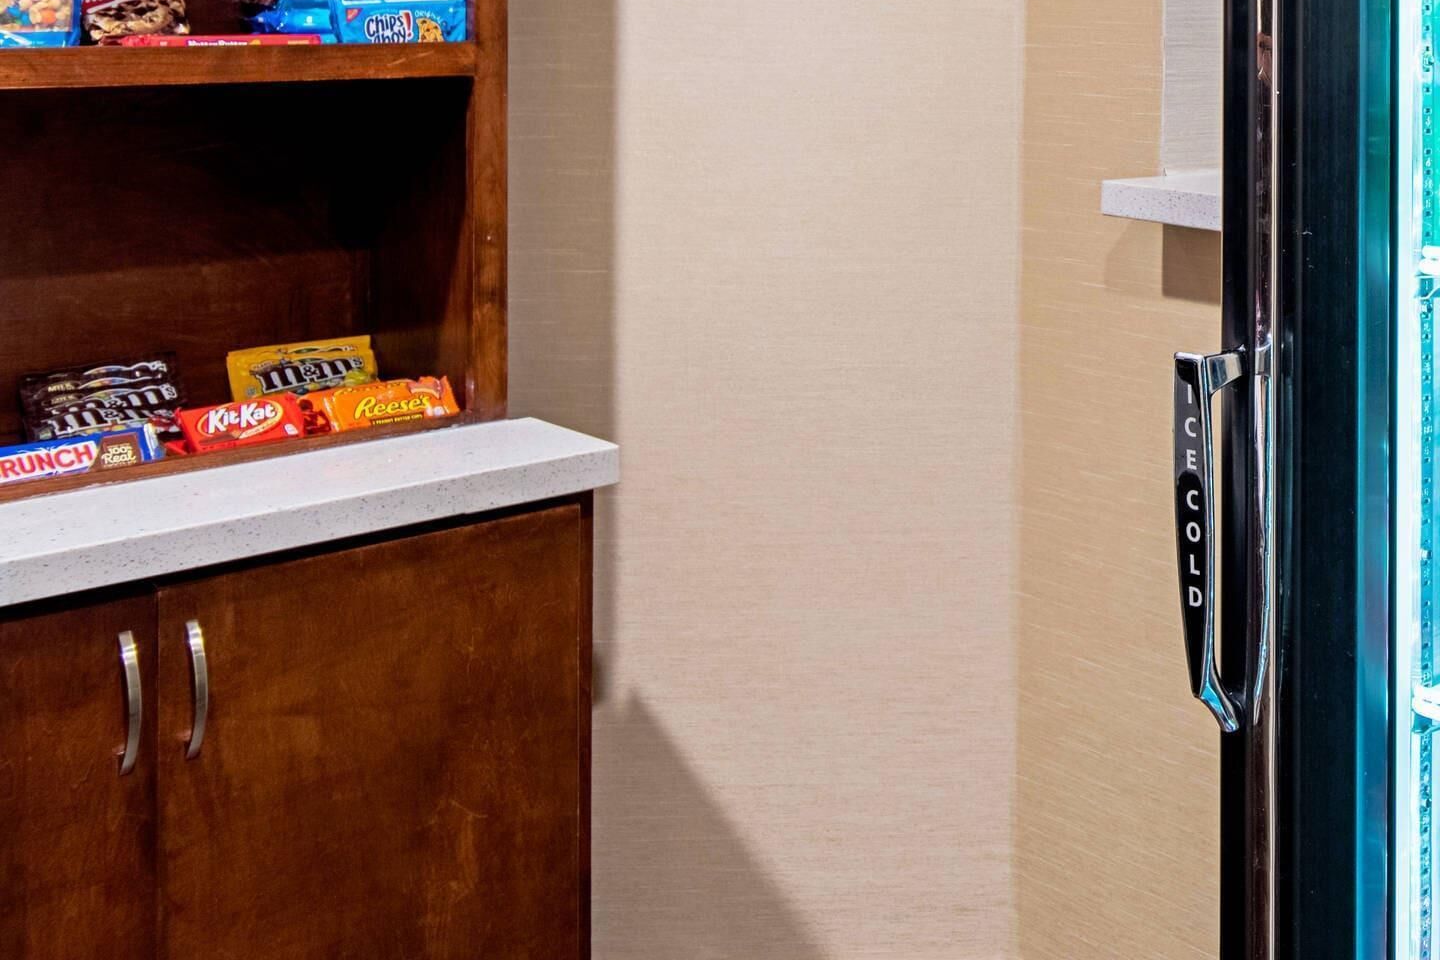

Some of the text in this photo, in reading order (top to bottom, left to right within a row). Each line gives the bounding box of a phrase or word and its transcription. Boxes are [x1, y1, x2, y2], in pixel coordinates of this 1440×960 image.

[365, 16, 404, 38] Chips
[354, 394, 431, 419] Reese's
[0, 442, 93, 478] RUNCH
[101, 452, 136, 464] Real
[1184, 383, 1203, 607] ICE COLD
